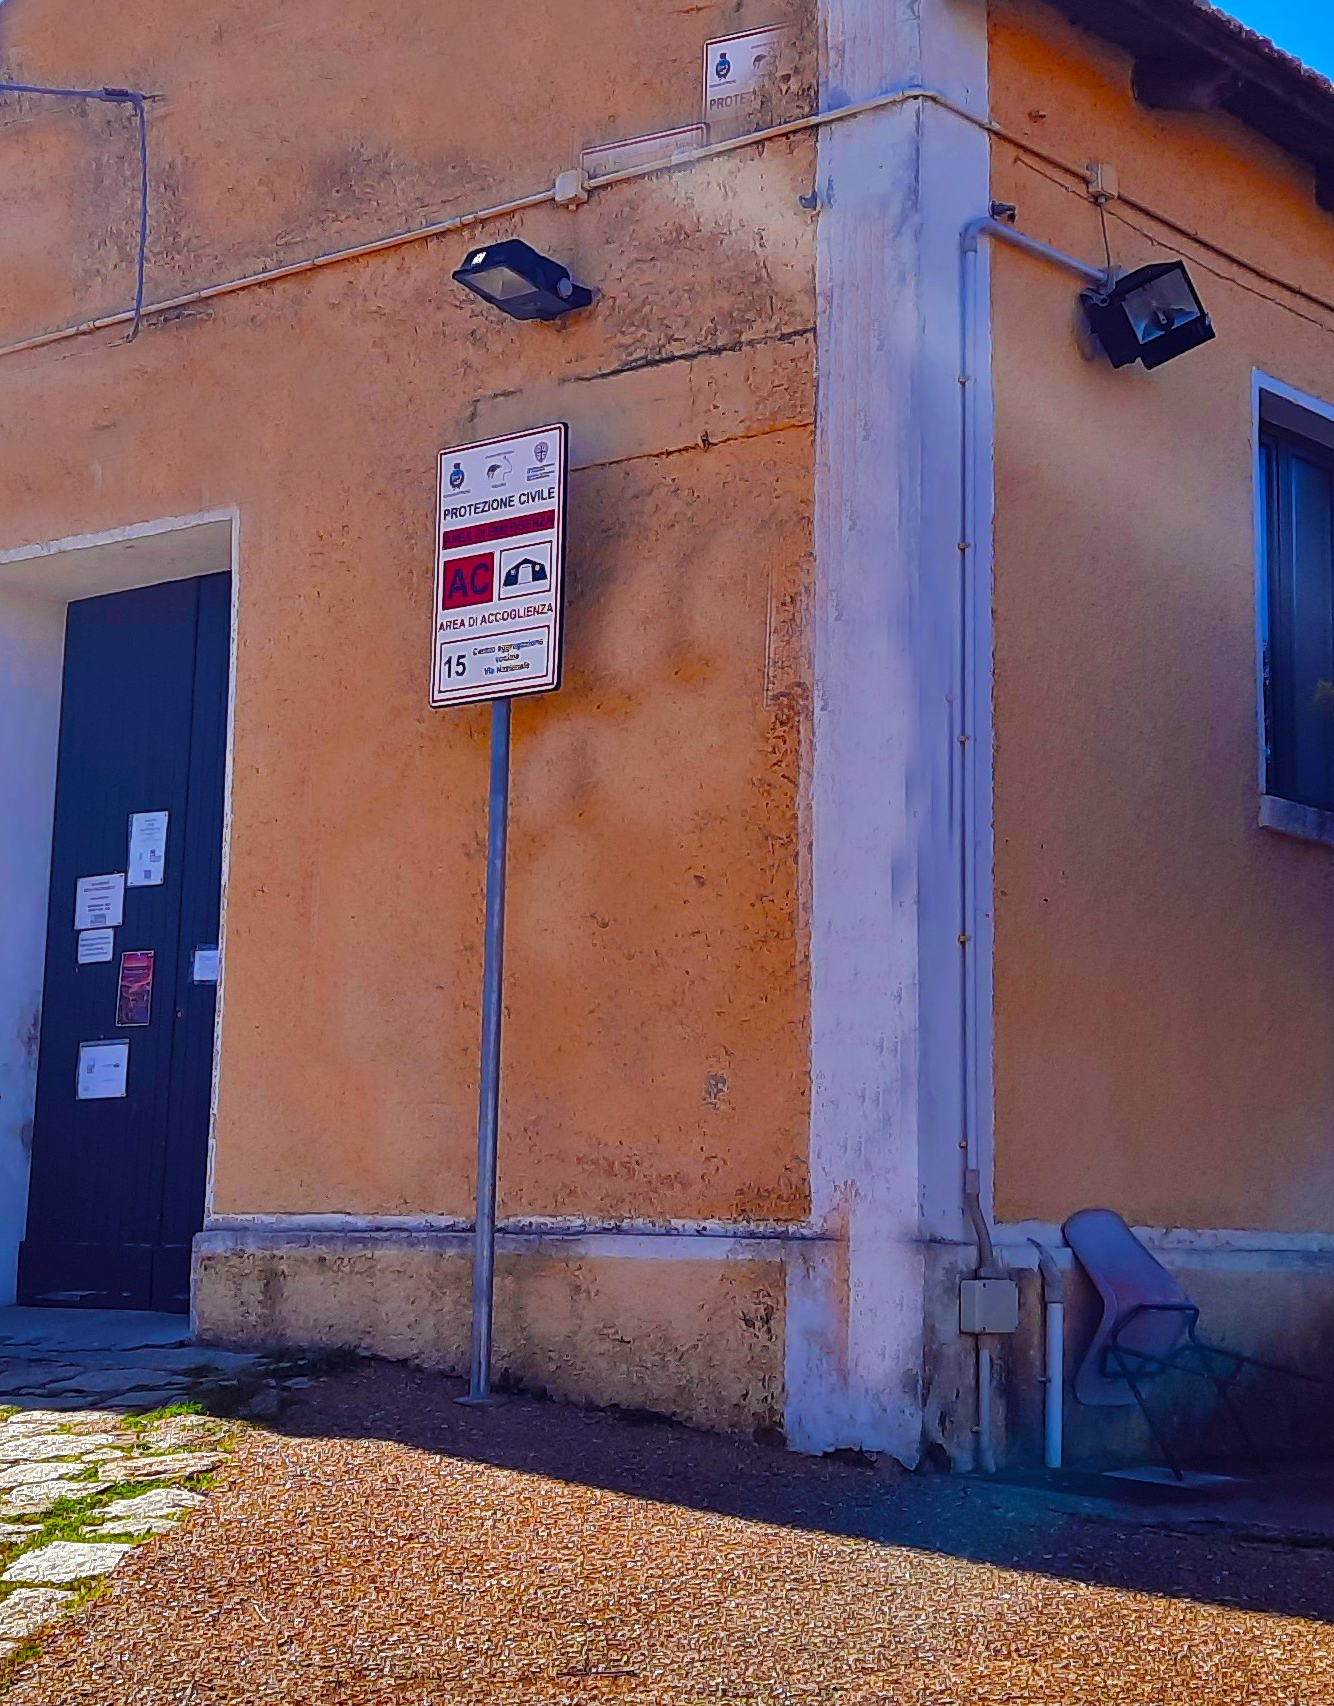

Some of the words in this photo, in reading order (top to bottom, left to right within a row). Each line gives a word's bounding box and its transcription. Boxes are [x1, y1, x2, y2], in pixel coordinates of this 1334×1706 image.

[444, 495, 515, 520] PROTEZIONE
[519, 487, 555, 505] CIVILE
[448, 563, 490, 600] AC
[438, 619, 465, 632] AREA
[468, 616, 478, 627] DI
[480, 603, 553, 626] ACCOGLIENZA
[444, 654, 466, 678] 15
